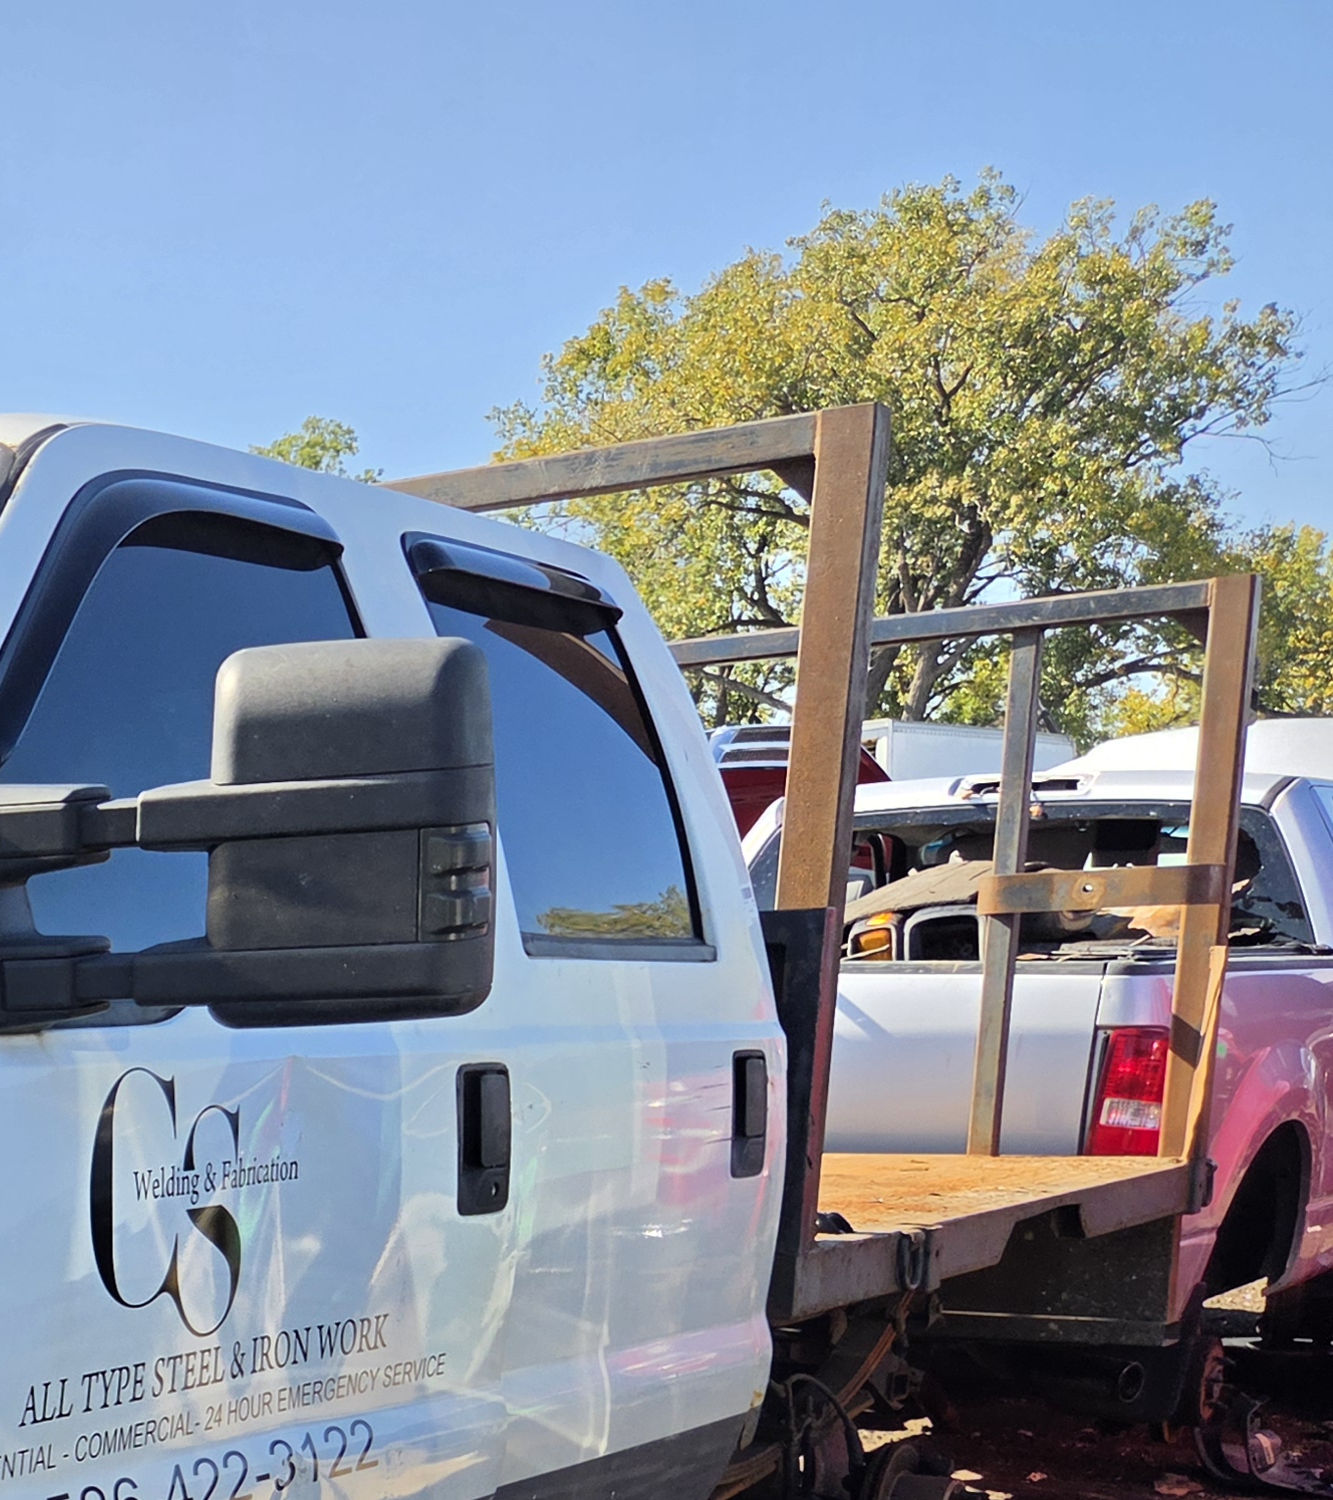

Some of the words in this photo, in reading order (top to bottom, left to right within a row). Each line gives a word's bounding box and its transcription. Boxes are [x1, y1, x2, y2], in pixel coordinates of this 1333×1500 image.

[133, 1167, 199, 1204] Welding
[203, 1162, 217, 1192] &
[221, 1157, 299, 1190] Fabrication
[18, 1378, 74, 1428] ALL
[80, 1362, 147, 1413] TYPE
[151, 1346, 225, 1398] STEEL
[230, 1341, 247, 1379] &
[250, 1326, 312, 1374] IRON
[317, 1313, 390, 1359] WORK
[204, 1405, 223, 1432] 24
[227, 1391, 273, 1424] HOUR
[277, 1368, 381, 1413] EMERGENCY
[382, 1353, 447, 1388] SERVICE
